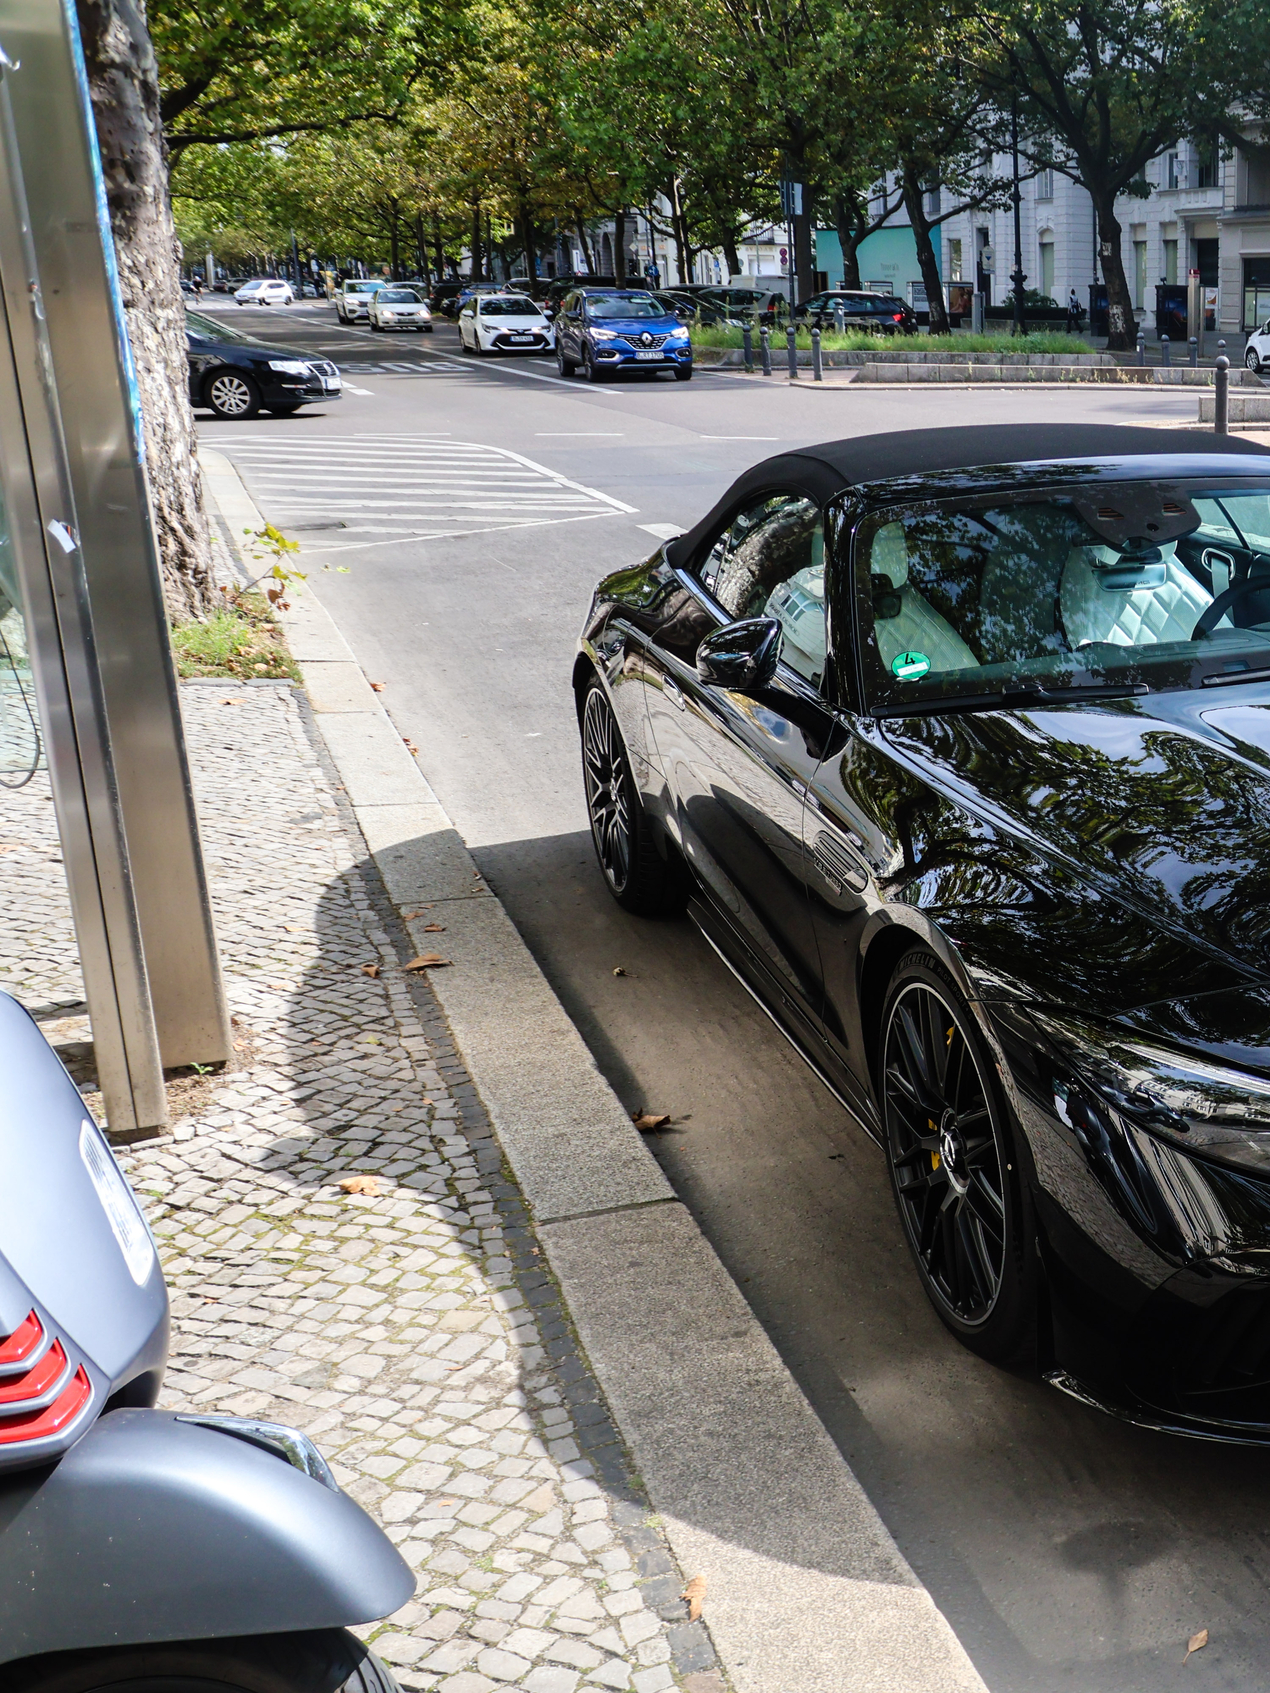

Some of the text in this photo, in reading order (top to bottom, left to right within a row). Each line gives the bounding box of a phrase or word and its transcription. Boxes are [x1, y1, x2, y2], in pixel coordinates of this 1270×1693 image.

[336, 361, 475, 373] BUS
[904, 652, 916, 665] 4
[899, 953, 936, 971] MICHELIN
[937, 966, 951, 982] PILOT
[950, 982, 967, 1006] SPORT
